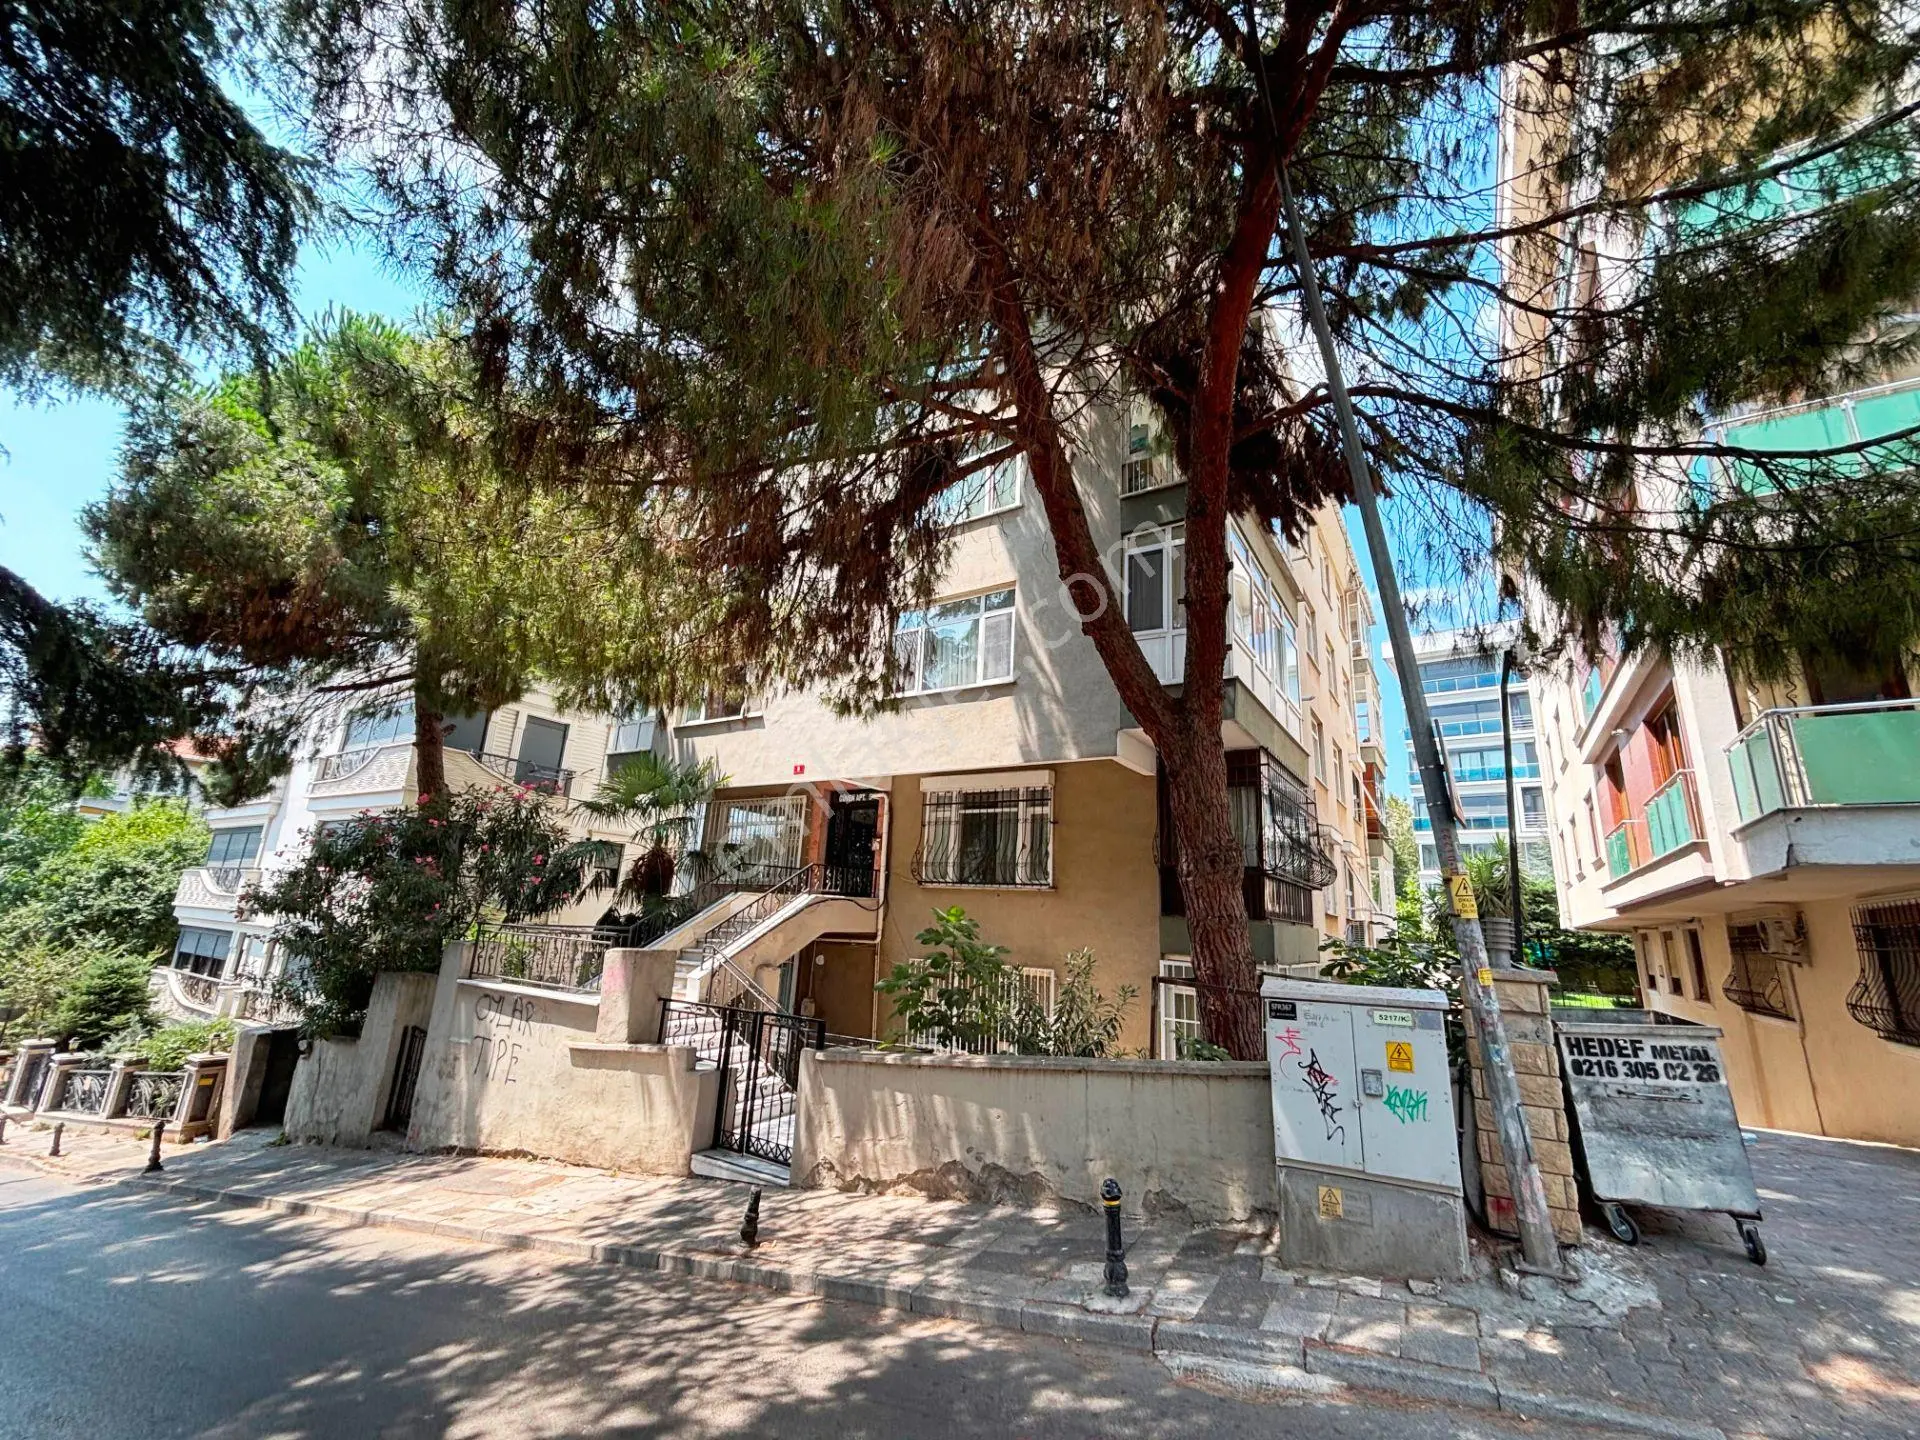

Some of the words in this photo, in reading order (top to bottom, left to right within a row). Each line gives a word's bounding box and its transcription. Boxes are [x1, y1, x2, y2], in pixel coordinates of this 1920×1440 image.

[474, 994, 535, 1036] OYLAR
[1565, 1036, 1644, 1058] HEDEF
[1571, 1058, 1618, 1078] 0216
[1623, 1061, 1660, 1080] 305
